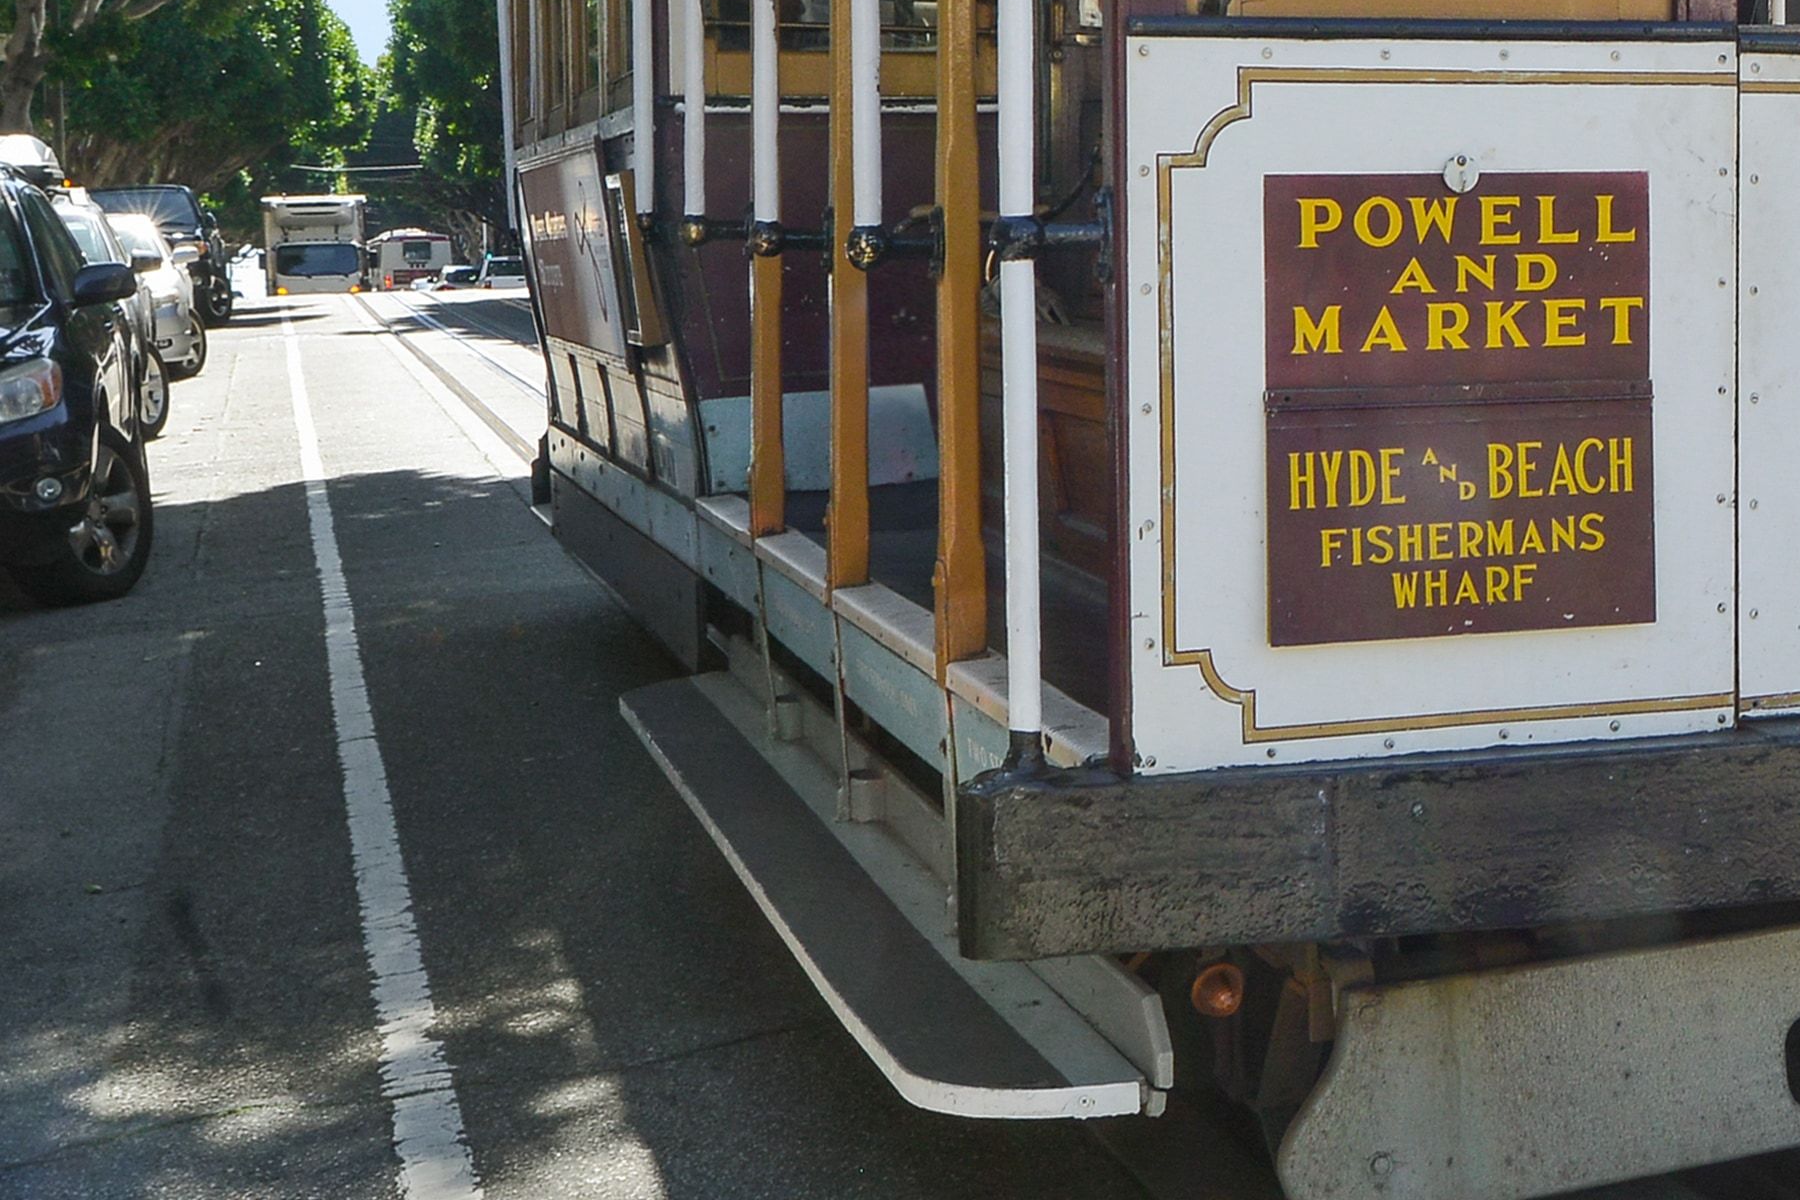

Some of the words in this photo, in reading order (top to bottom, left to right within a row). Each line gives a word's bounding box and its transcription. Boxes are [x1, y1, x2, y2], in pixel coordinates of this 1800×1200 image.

[1296, 195, 1636, 248] POWELL
[1390, 253, 1559, 293] AND
[1291, 297, 1643, 354] MARKET
[1288, 448, 1406, 510] HYDE
[1422, 447, 1477, 501] AND
[1487, 437, 1633, 499] BEACH
[1320, 512, 1606, 567] FISHERMANS
[1392, 563, 1538, 609] WHARF
